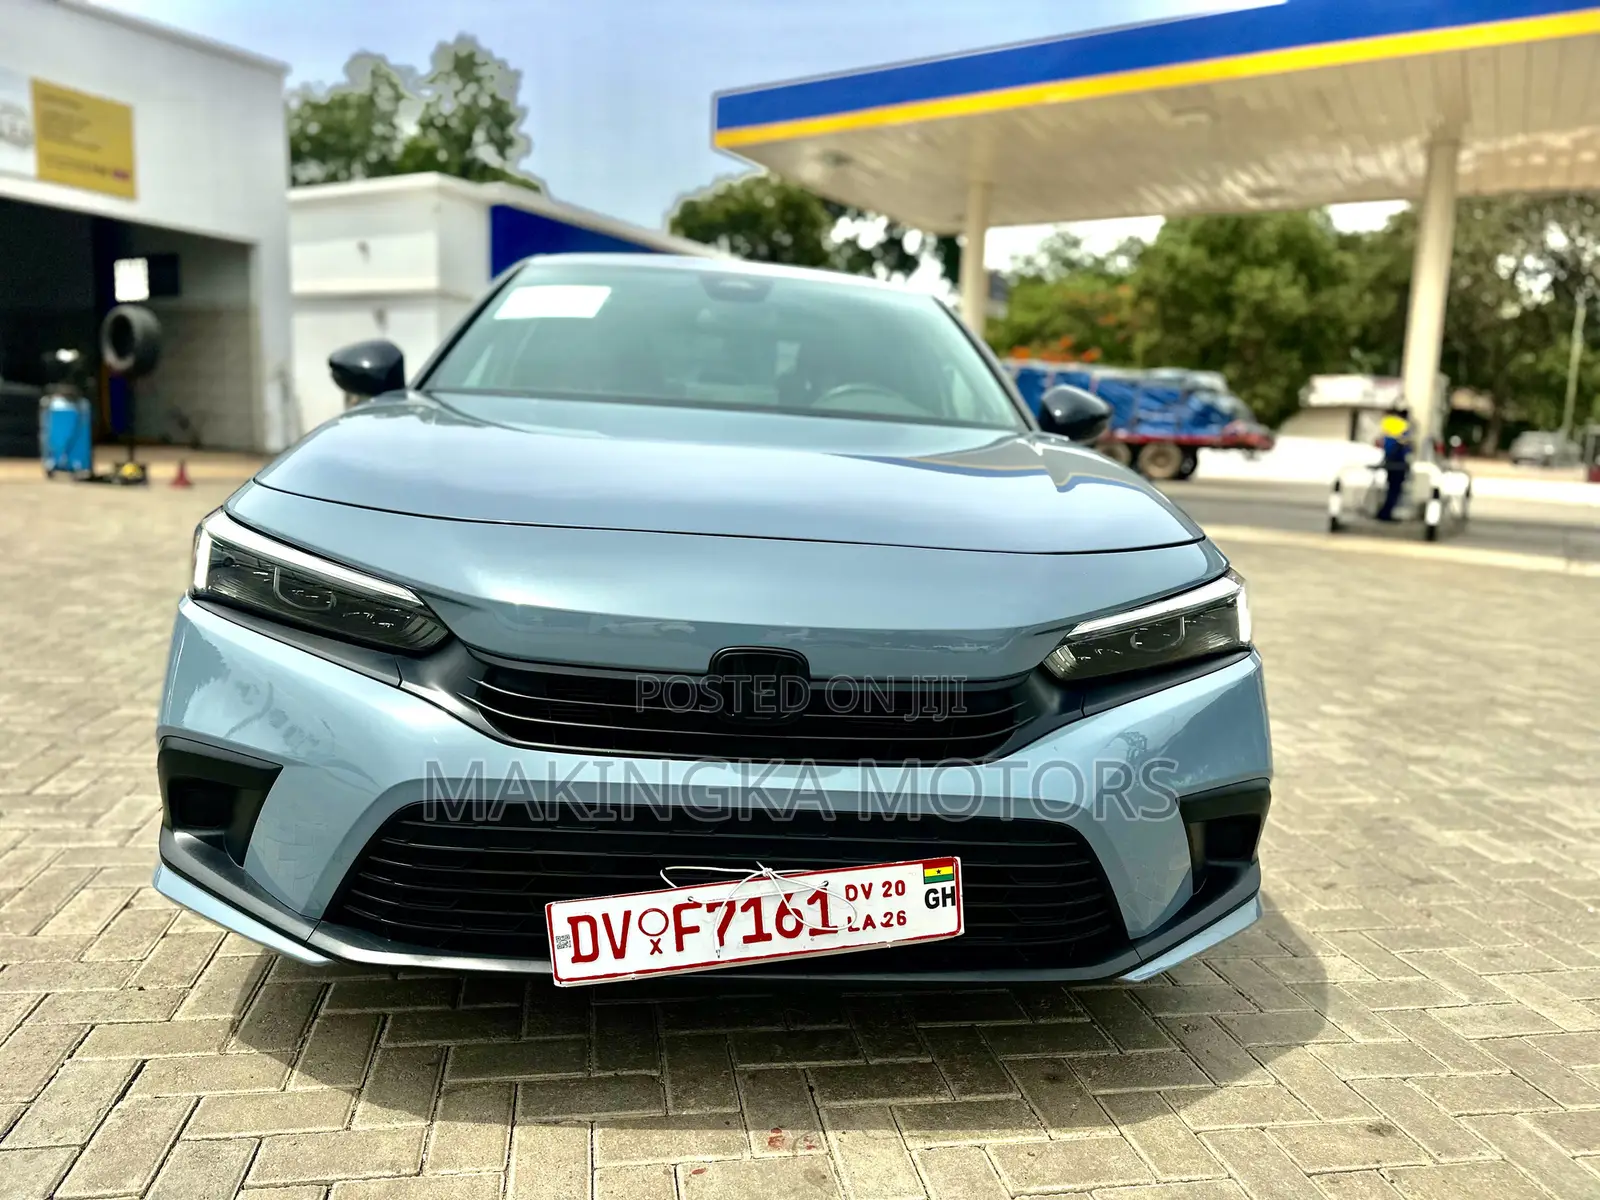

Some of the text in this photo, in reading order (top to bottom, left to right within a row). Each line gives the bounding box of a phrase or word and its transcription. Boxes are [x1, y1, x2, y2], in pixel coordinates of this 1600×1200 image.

[844, 879, 906, 902] DV 20
[924, 885, 956, 910] GH
[566, 909, 632, 964] DV
